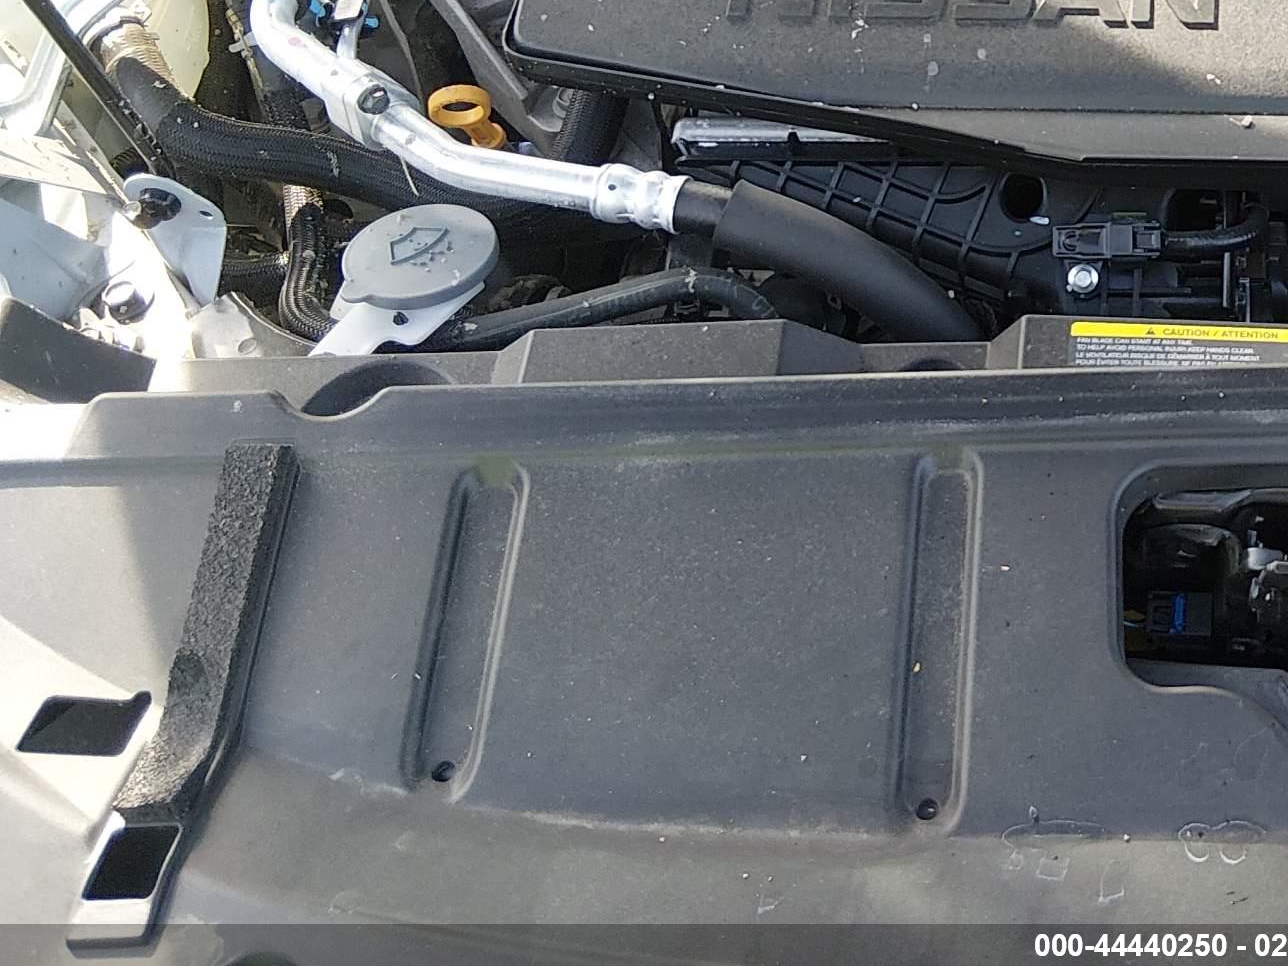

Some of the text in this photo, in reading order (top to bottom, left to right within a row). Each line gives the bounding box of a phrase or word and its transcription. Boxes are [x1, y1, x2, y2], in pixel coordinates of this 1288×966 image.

[1162, 327, 1209, 338] CAUTION
[1221, 329, 1279, 340] ATTENTION
[1076, 343, 1087, 351] TO
[1106, 344, 1127, 352] AVOID
[1167, 352, 1205, 360] DÉMARRER
